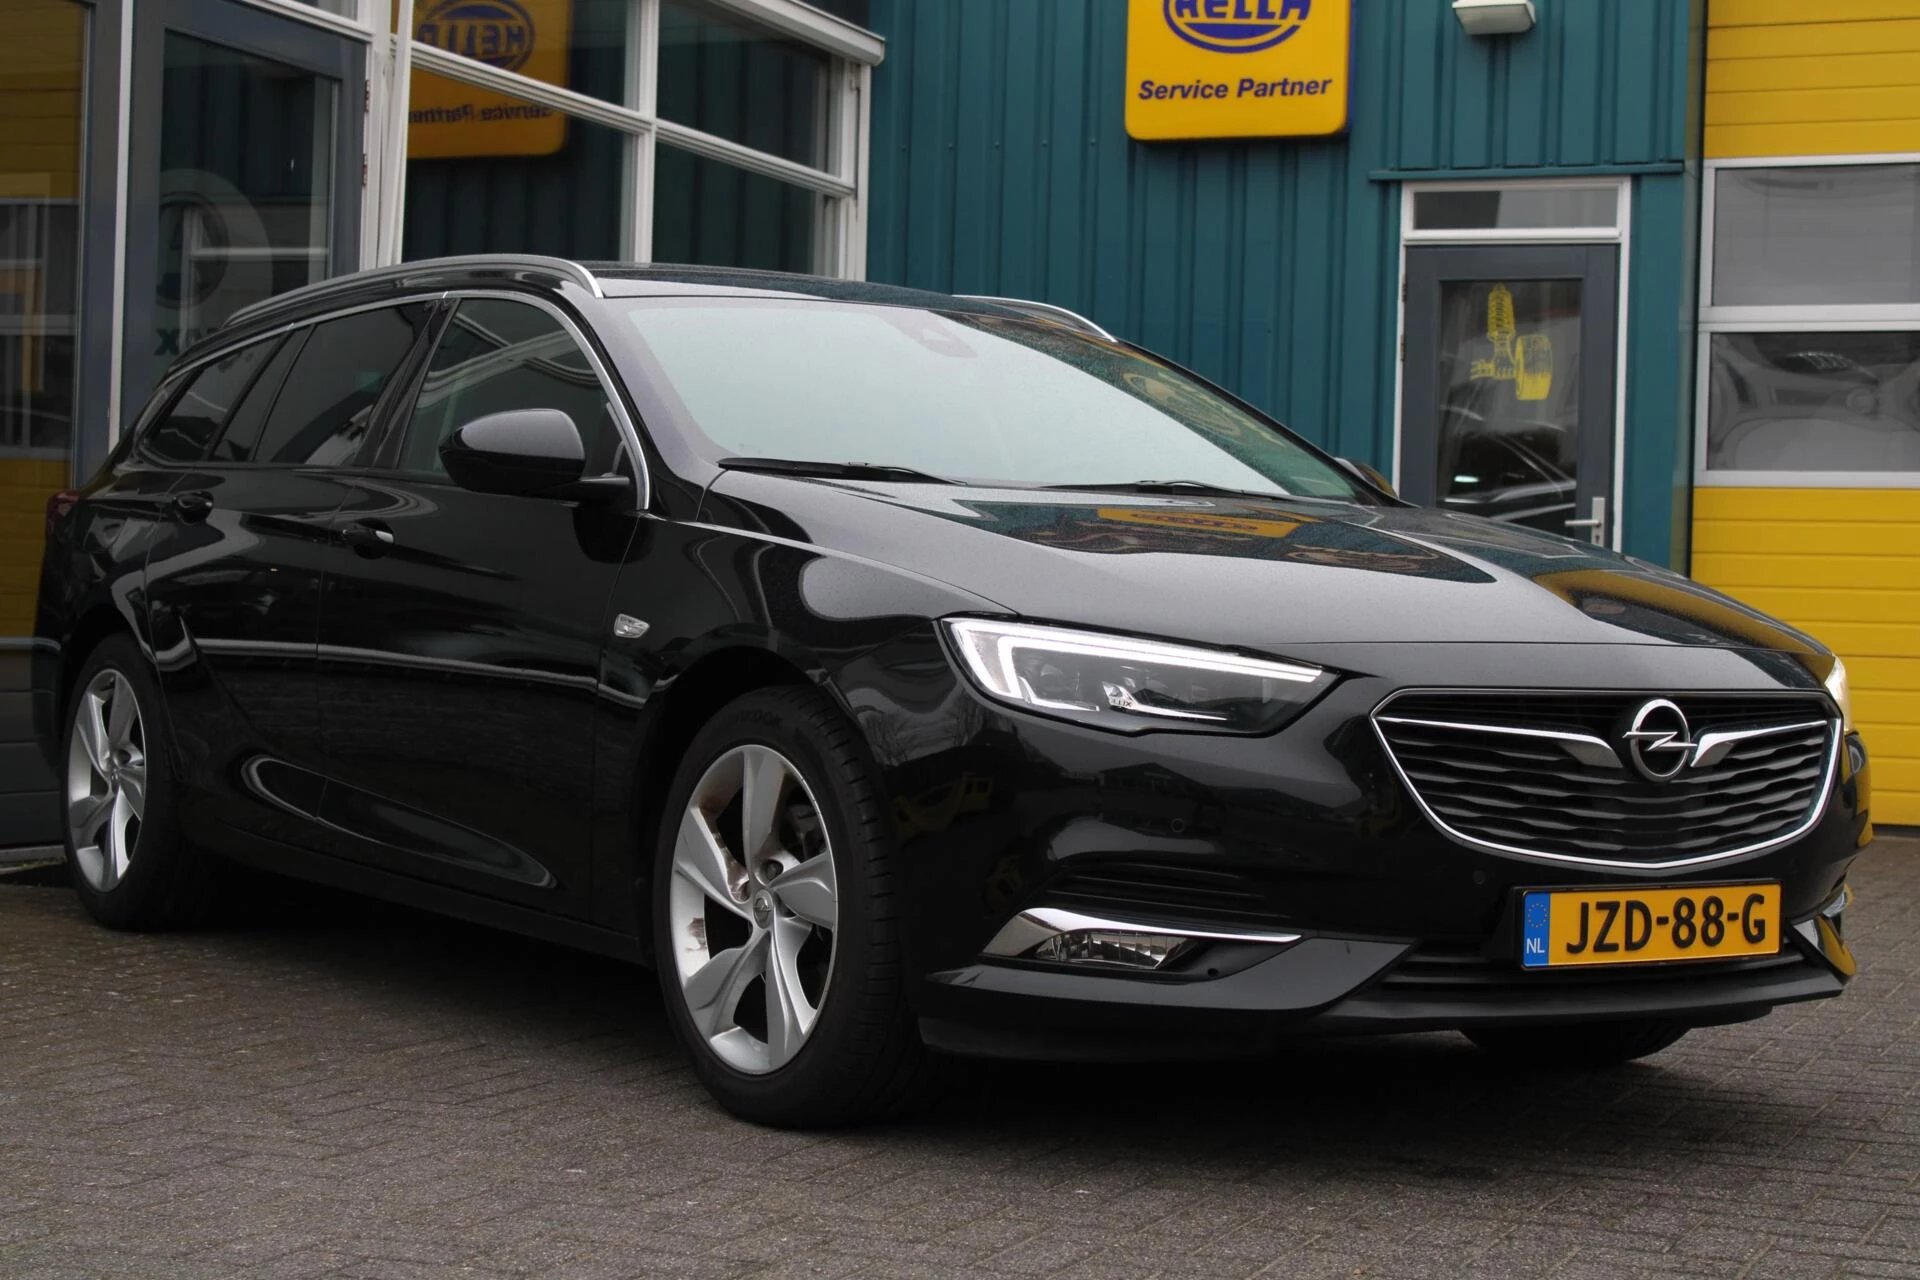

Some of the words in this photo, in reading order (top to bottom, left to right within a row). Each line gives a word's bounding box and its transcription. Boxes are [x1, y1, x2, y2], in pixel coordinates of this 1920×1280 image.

[1138, 79, 1228, 101] Service
[1236, 77, 1332, 99] Partner
[1565, 893, 1766, 955] JZD-88-G
[1526, 937, 1545, 954] NL
